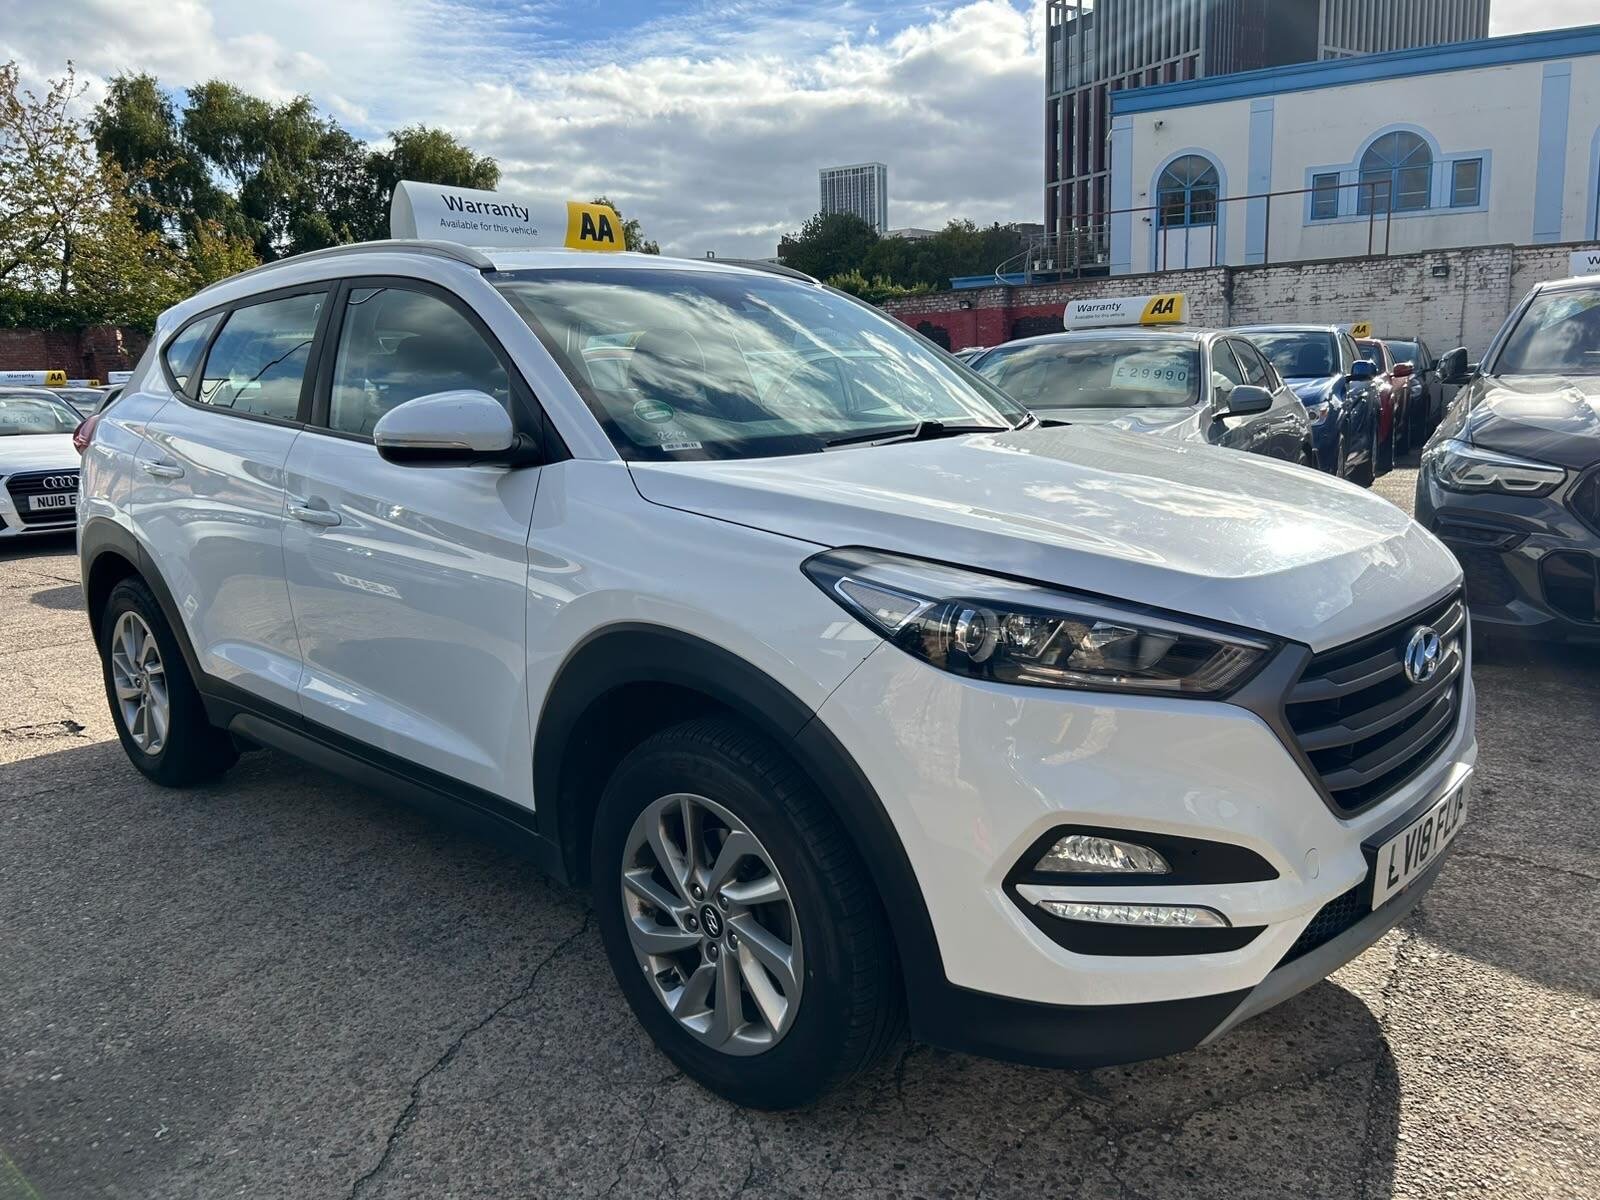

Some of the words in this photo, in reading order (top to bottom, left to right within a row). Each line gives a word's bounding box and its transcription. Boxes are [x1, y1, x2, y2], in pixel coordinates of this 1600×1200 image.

[441, 194, 529, 222] Warranty
[440, 218, 479, 231] Available
[480, 221, 492, 232] for
[493, 223, 509, 233] this
[510, 226, 538, 236] vehicle
[580, 212, 615, 243] AA
[1077, 302, 1122, 312] Warranty
[1150, 298, 1176, 315] AA
[1352, 324, 1368, 334] AA
[51, 372, 63, 381] AA
[37, 496, 66, 508] NU18
